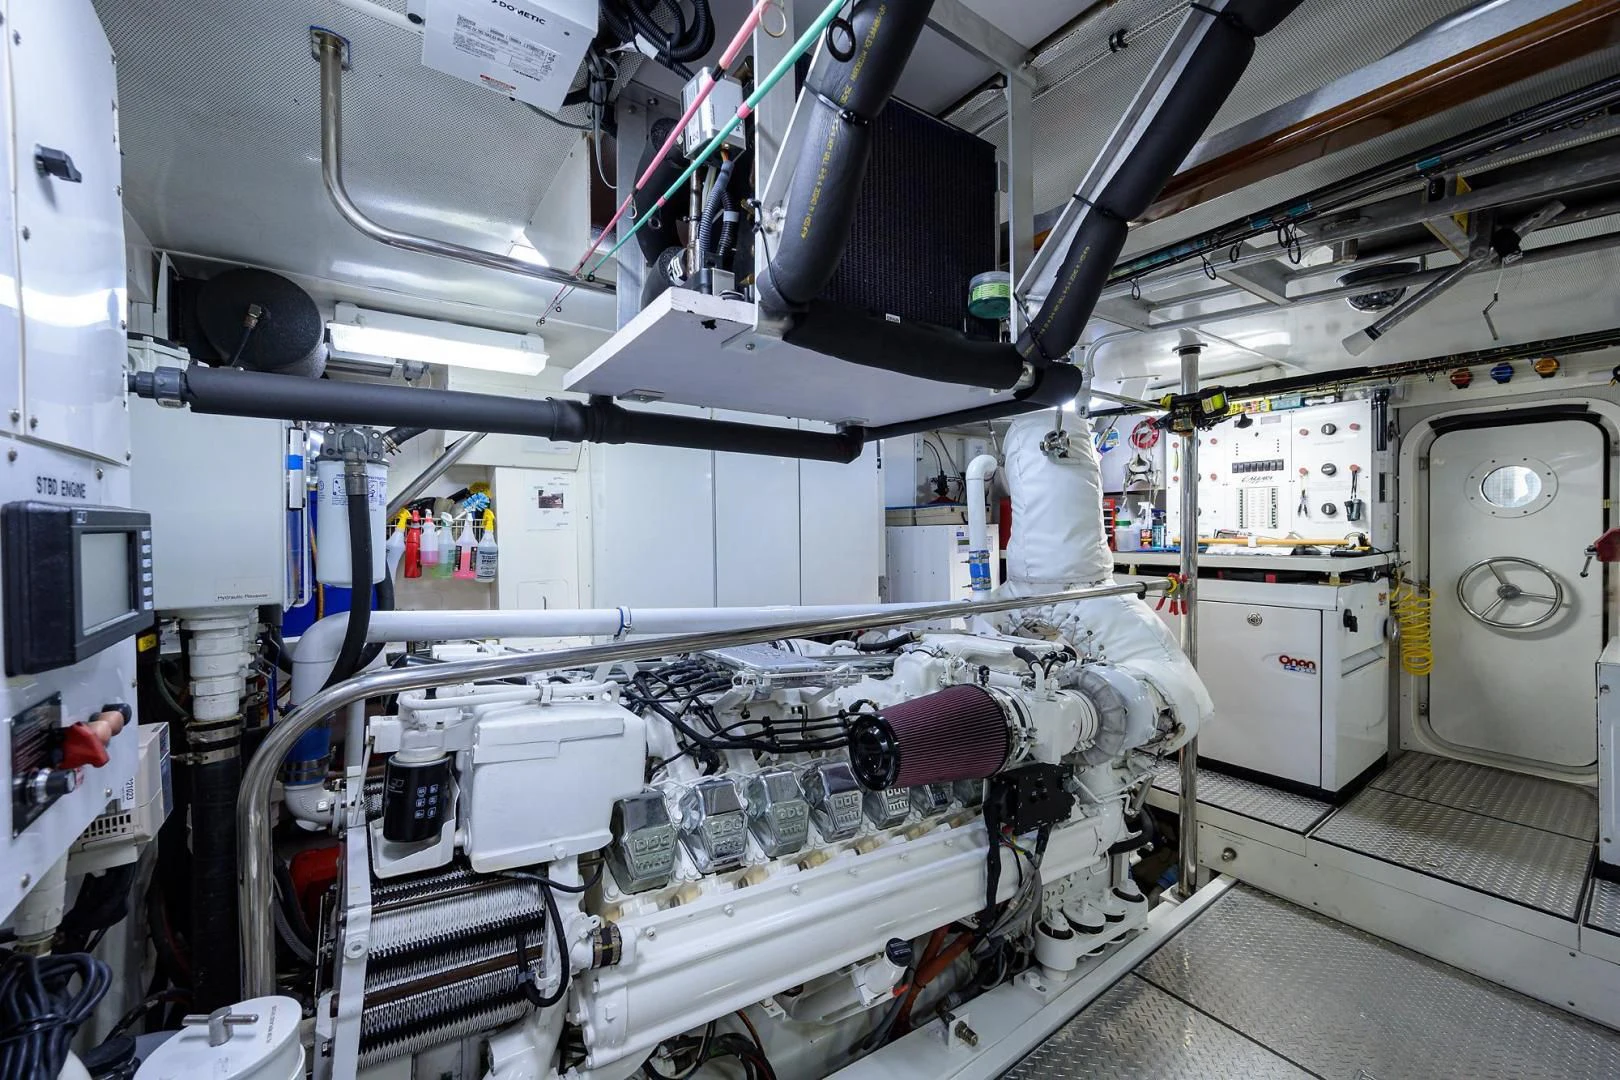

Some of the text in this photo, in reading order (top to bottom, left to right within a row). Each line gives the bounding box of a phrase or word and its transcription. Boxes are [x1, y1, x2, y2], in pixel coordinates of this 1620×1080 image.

[499, 1, 546, 25] DOMETIC
[36, 476, 86, 499] STBD ENGINE
[1279, 655, 1316, 669] Onan
[888, 799, 909, 811] mtu
